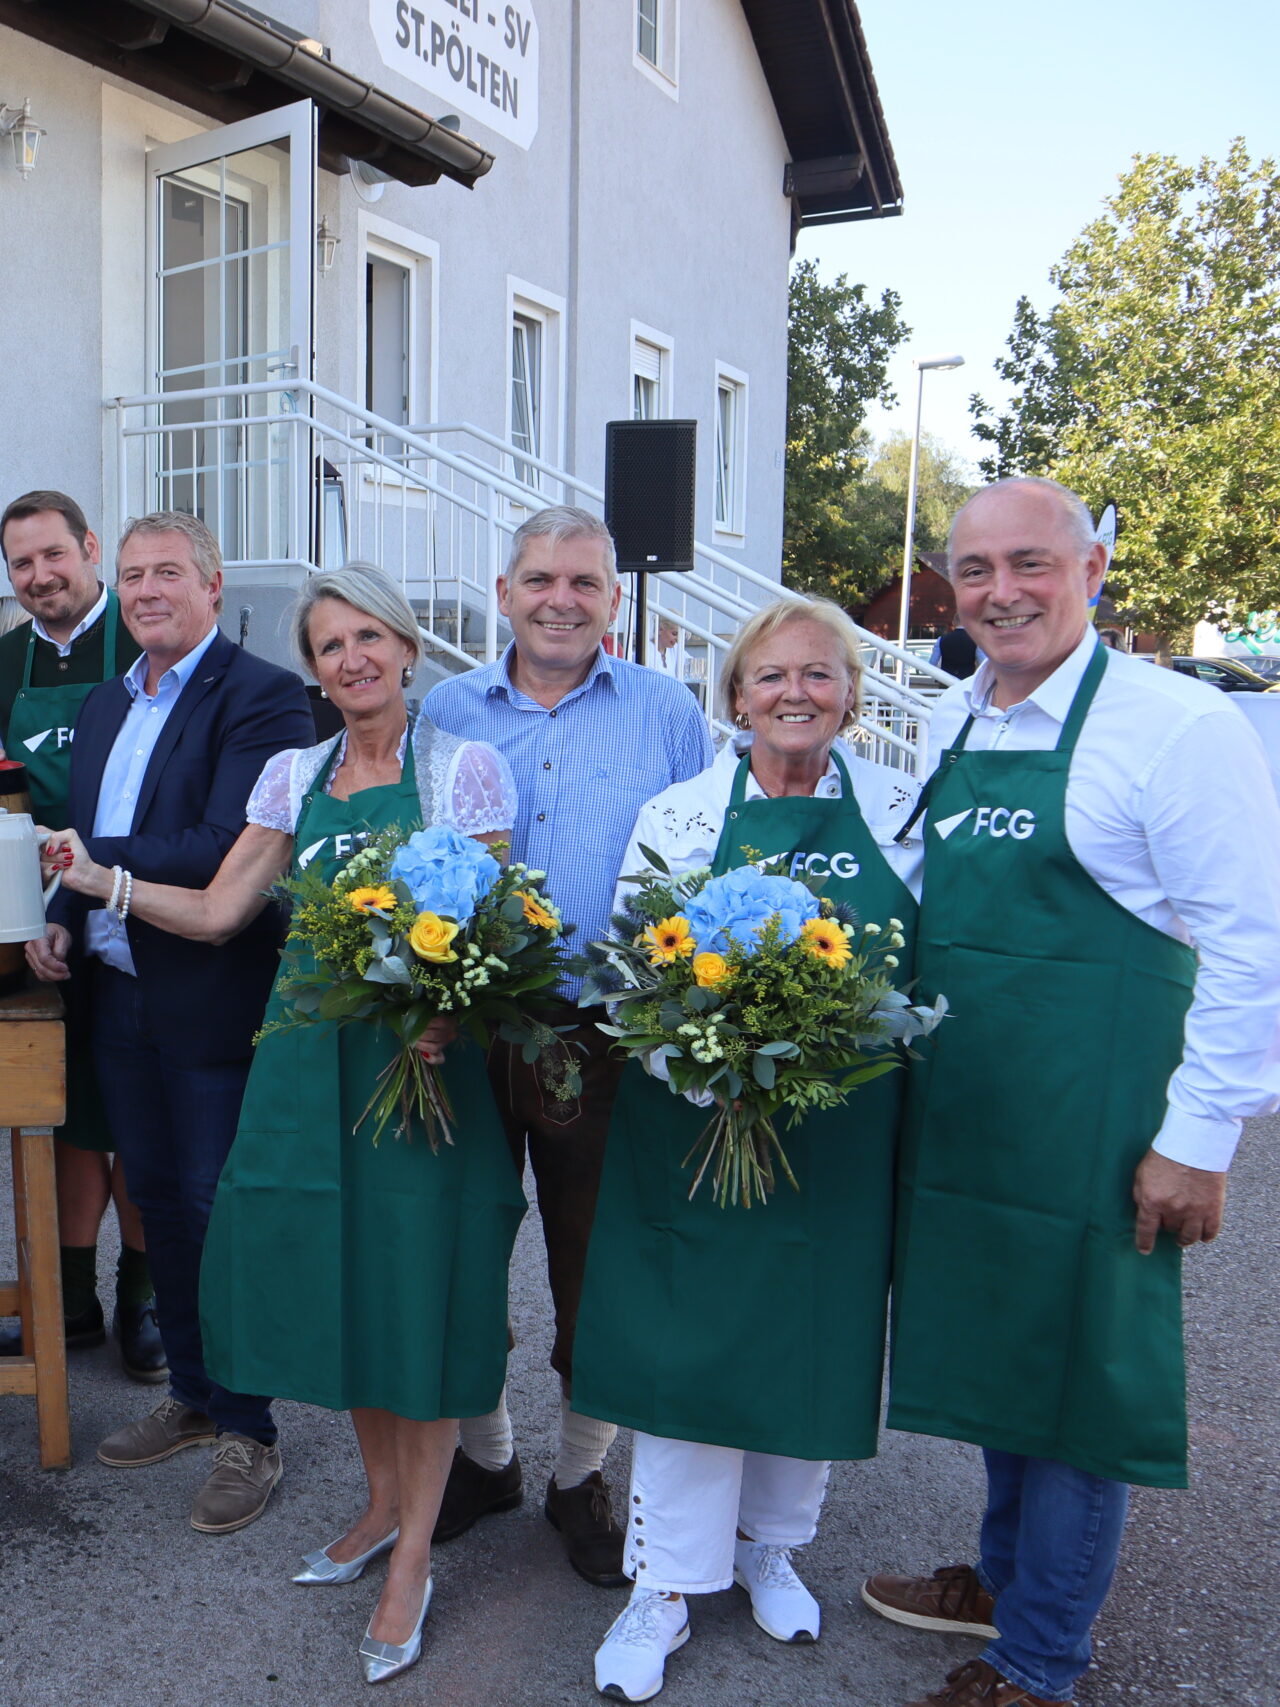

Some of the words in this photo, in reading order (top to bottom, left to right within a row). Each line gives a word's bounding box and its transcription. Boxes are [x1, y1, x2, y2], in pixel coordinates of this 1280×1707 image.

[503, 4, 531, 57] SV
[973, 807, 1036, 840] FCG
[790, 852, 860, 879] FCG
